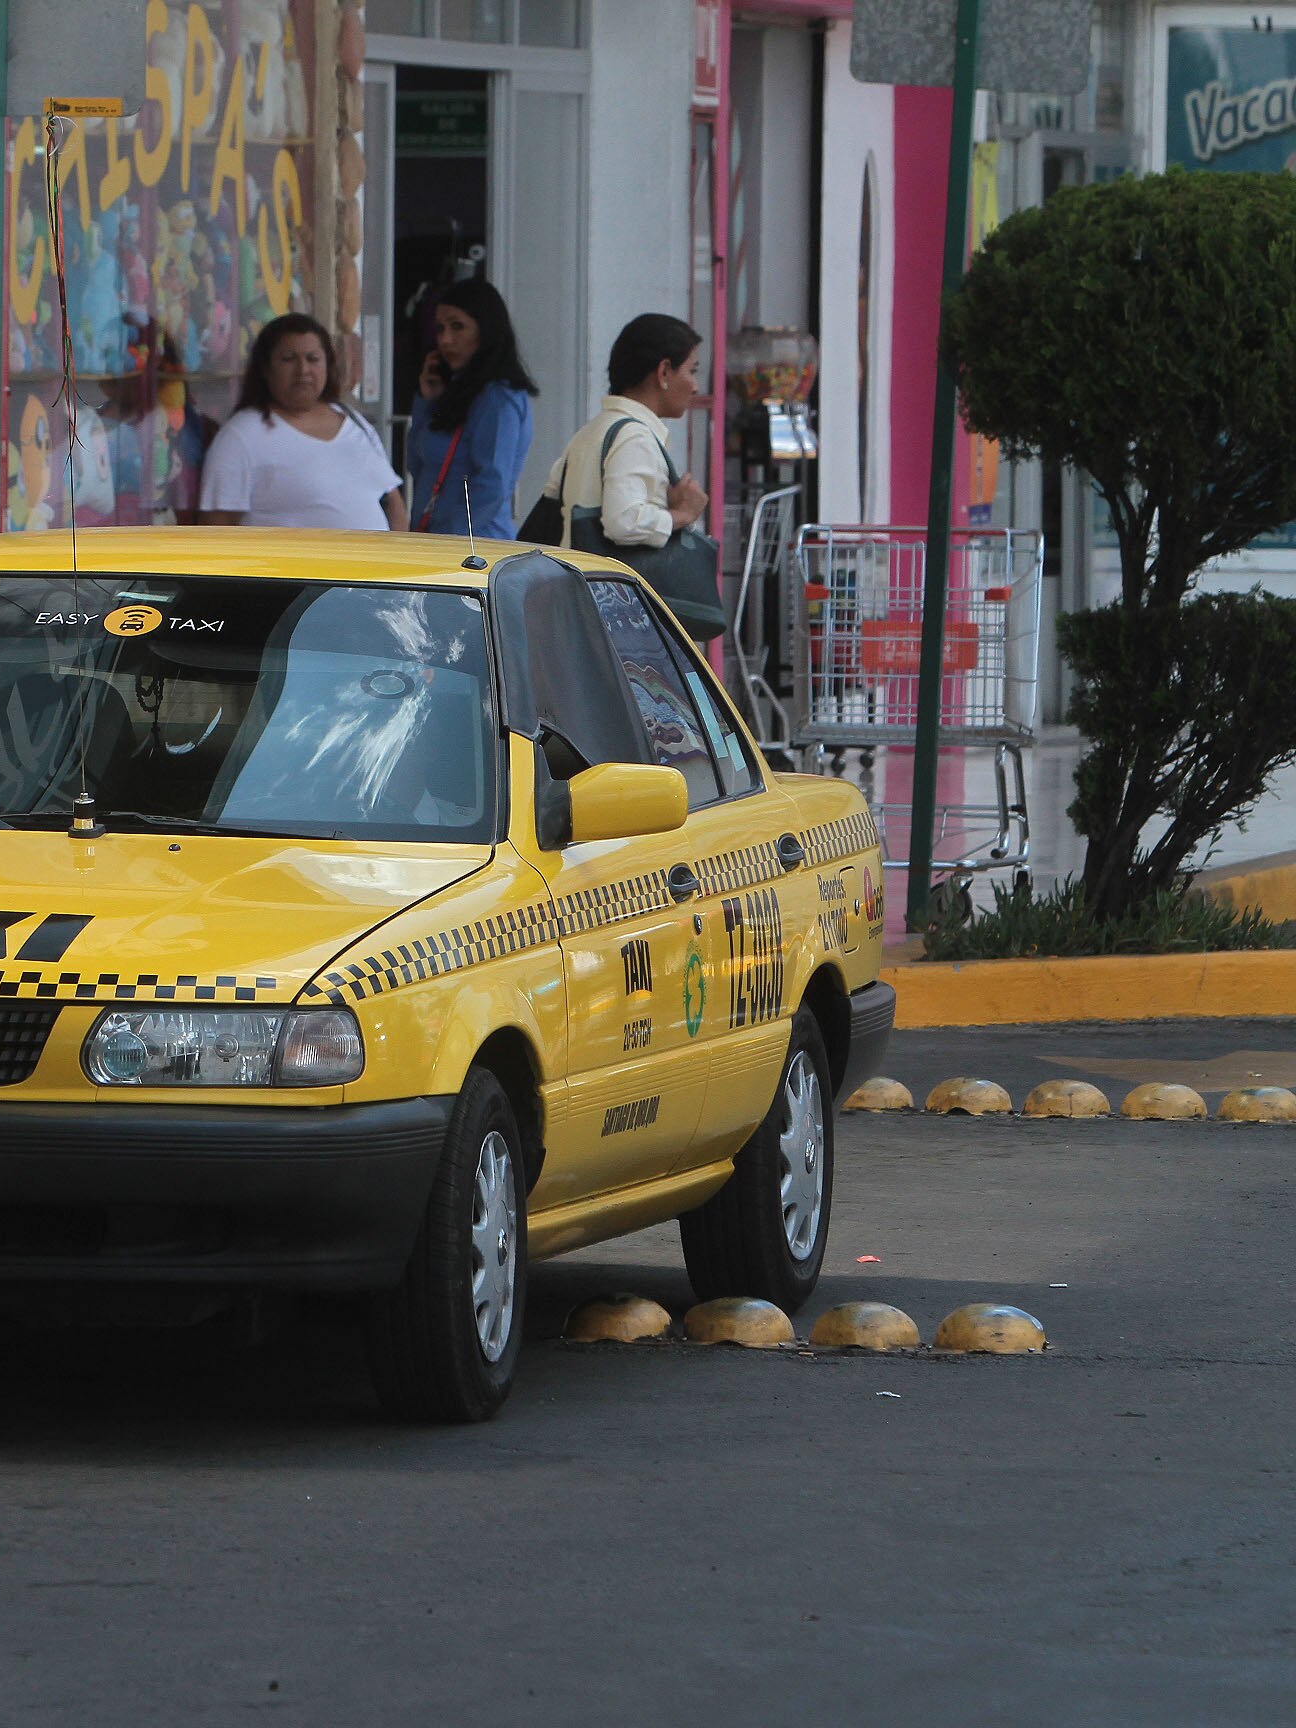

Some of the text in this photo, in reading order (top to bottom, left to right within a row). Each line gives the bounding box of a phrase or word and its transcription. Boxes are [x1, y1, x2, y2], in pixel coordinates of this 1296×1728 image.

[1186, 82, 1296, 162] Vaca
[34, 612, 225, 632] EASY TAXI
[816, 873, 847, 908] Reportes
[620, 939, 653, 996] TAXI
